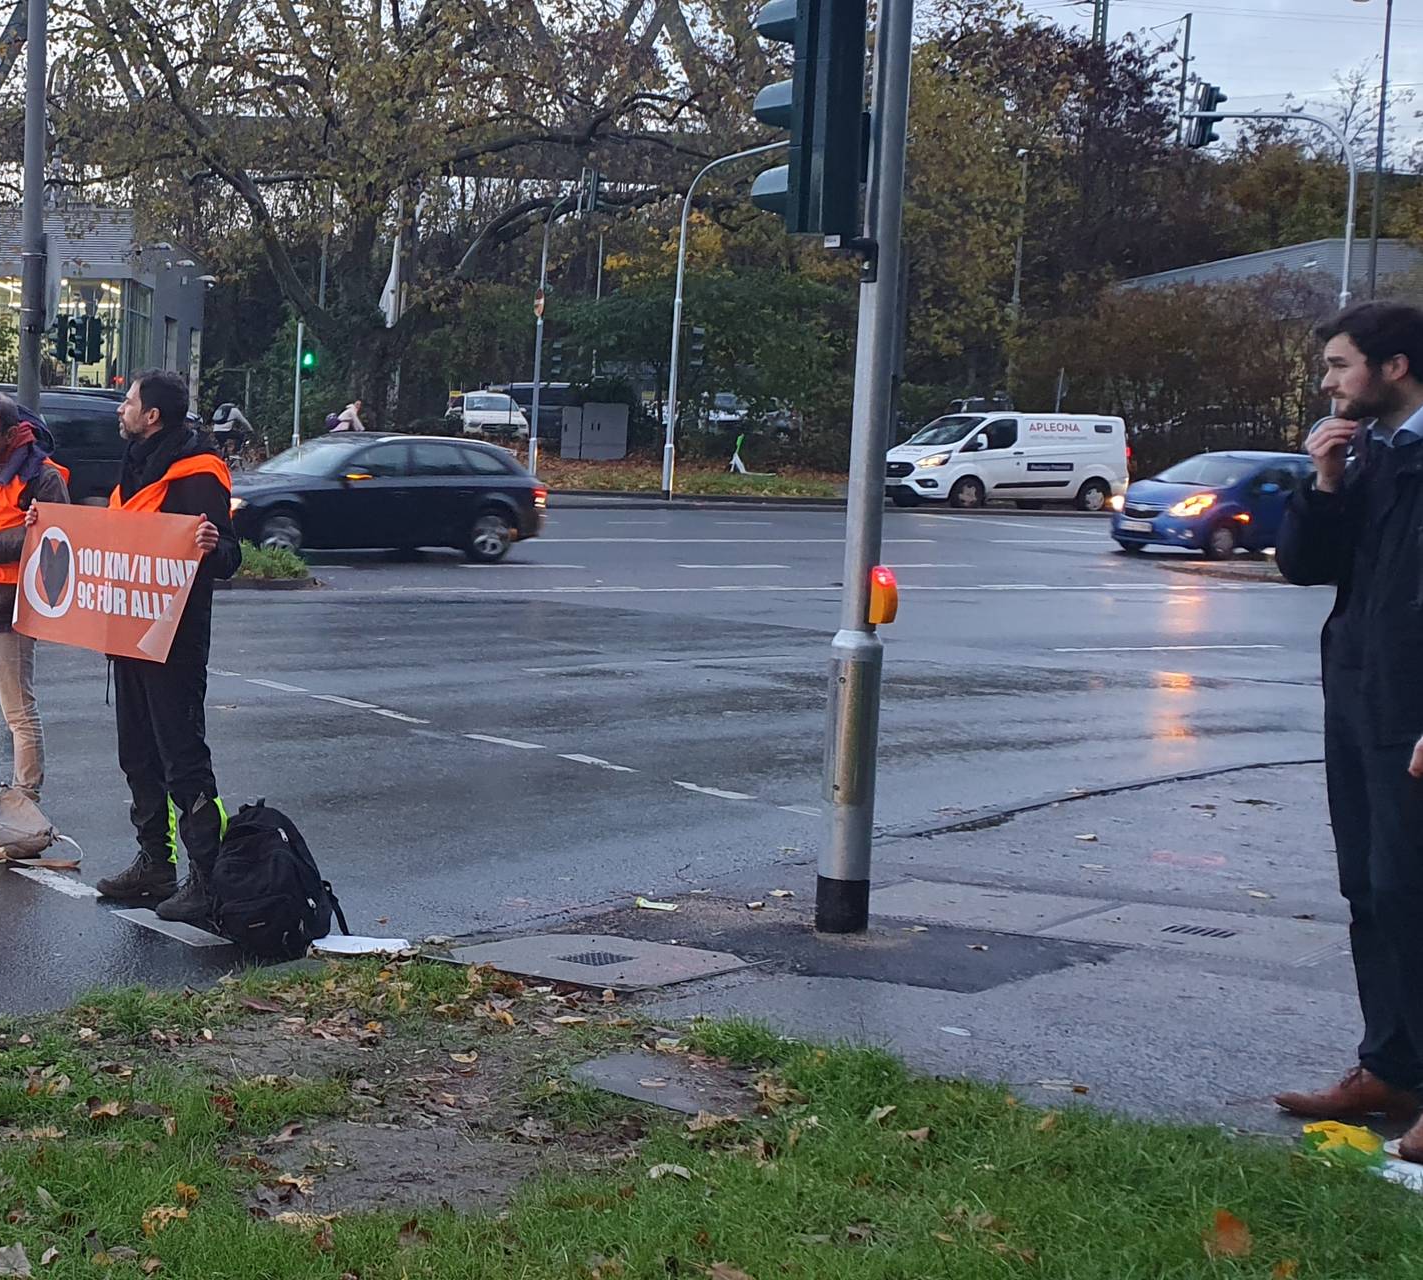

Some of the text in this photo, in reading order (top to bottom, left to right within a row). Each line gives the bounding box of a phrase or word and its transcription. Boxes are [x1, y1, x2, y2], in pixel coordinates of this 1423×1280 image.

[1029, 422, 1081, 432] APLEONA
[77, 547, 102, 577] 100
[104, 551, 151, 585] KM/H
[97, 580, 127, 616] FÜR
